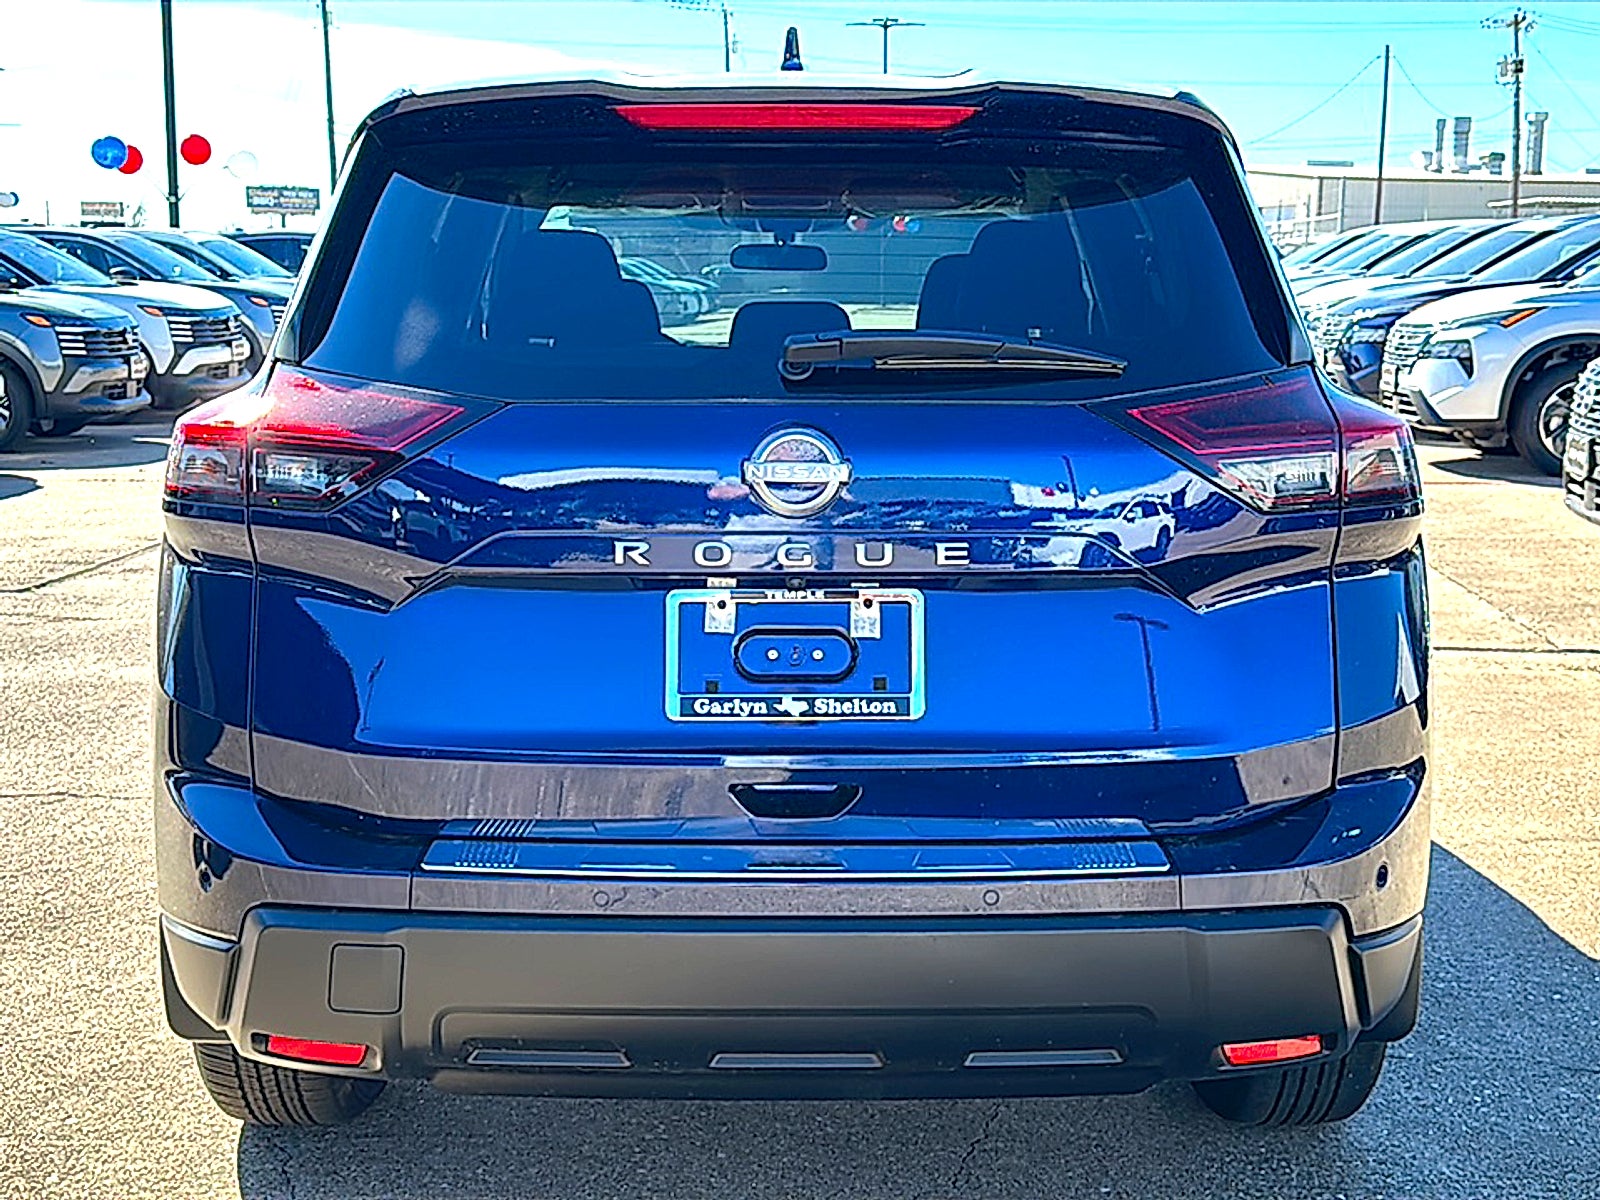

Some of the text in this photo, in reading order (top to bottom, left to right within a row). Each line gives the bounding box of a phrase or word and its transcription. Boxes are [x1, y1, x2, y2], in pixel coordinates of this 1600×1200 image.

[747, 465, 848, 479] NISSAN
[614, 541, 971, 567] ROGUE
[765, 590, 825, 600] TEMPLE
[693, 698, 897, 717] Garlyn Shelton
